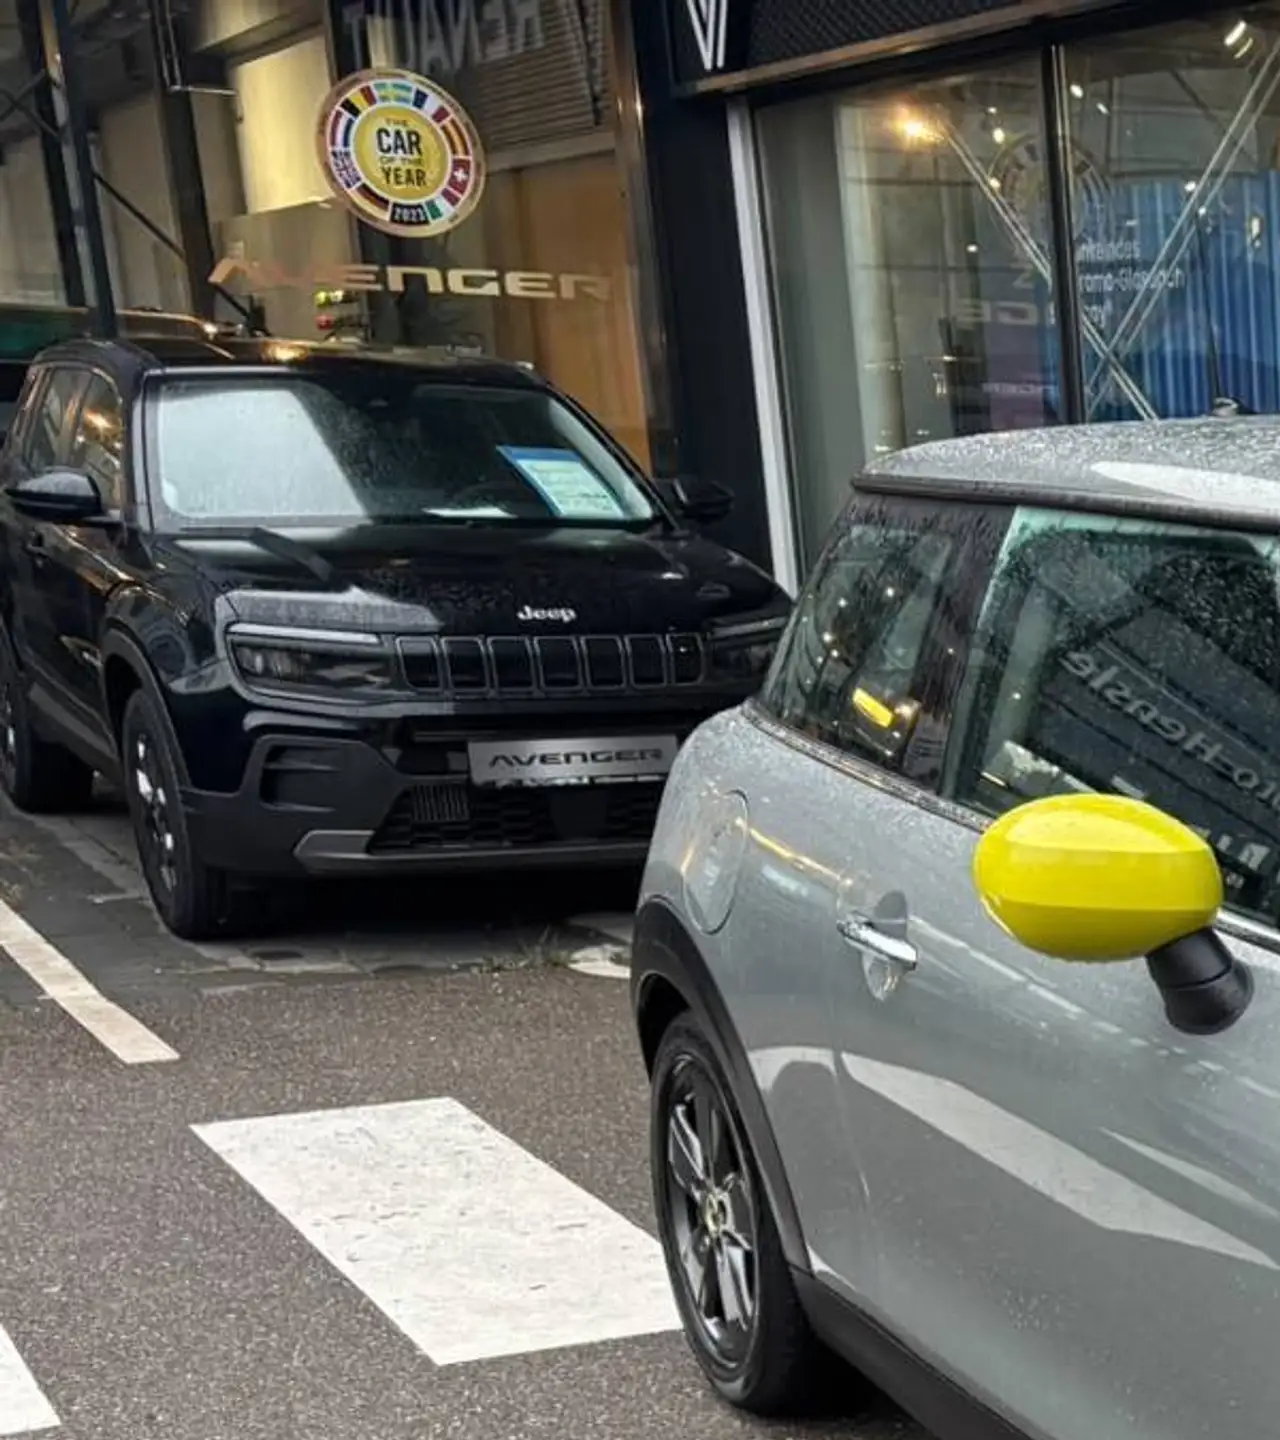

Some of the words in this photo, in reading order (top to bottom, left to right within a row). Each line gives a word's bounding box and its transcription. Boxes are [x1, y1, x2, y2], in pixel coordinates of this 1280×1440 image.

[376, 128, 422, 154] CAR
[381, 166, 426, 186] YEAR
[516, 604, 577, 623] Jeep
[489, 748, 664, 768] AVENGER
